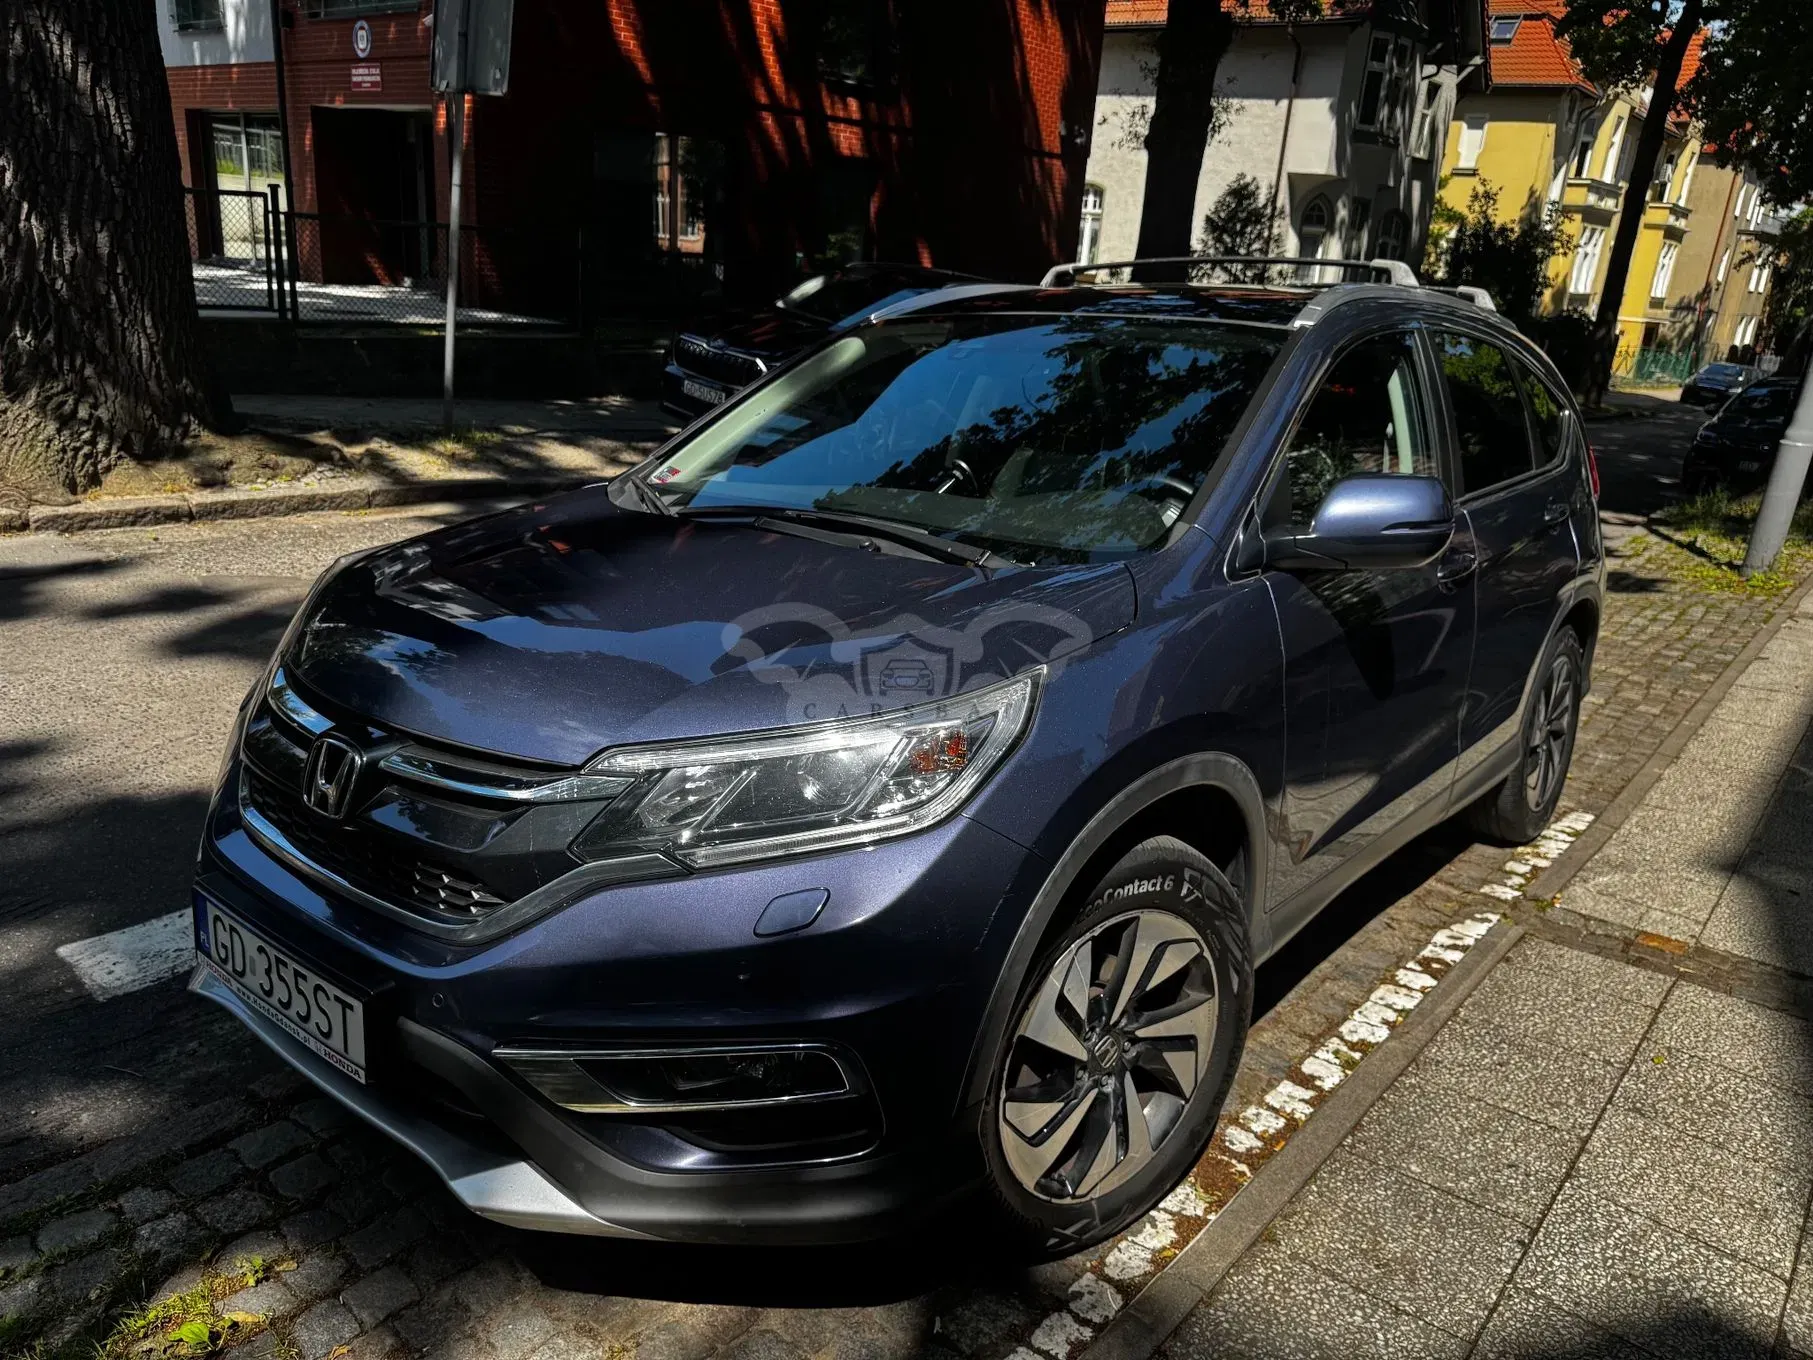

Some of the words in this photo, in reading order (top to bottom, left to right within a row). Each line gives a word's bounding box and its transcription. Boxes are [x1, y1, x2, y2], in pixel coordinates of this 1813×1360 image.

[200, 930, 209, 948] PL
[212, 914, 246, 979] GD
[256, 944, 354, 1055] 355ST
[206, 961, 233, 987] HONDA
[323, 1048, 361, 1080] HONDA
